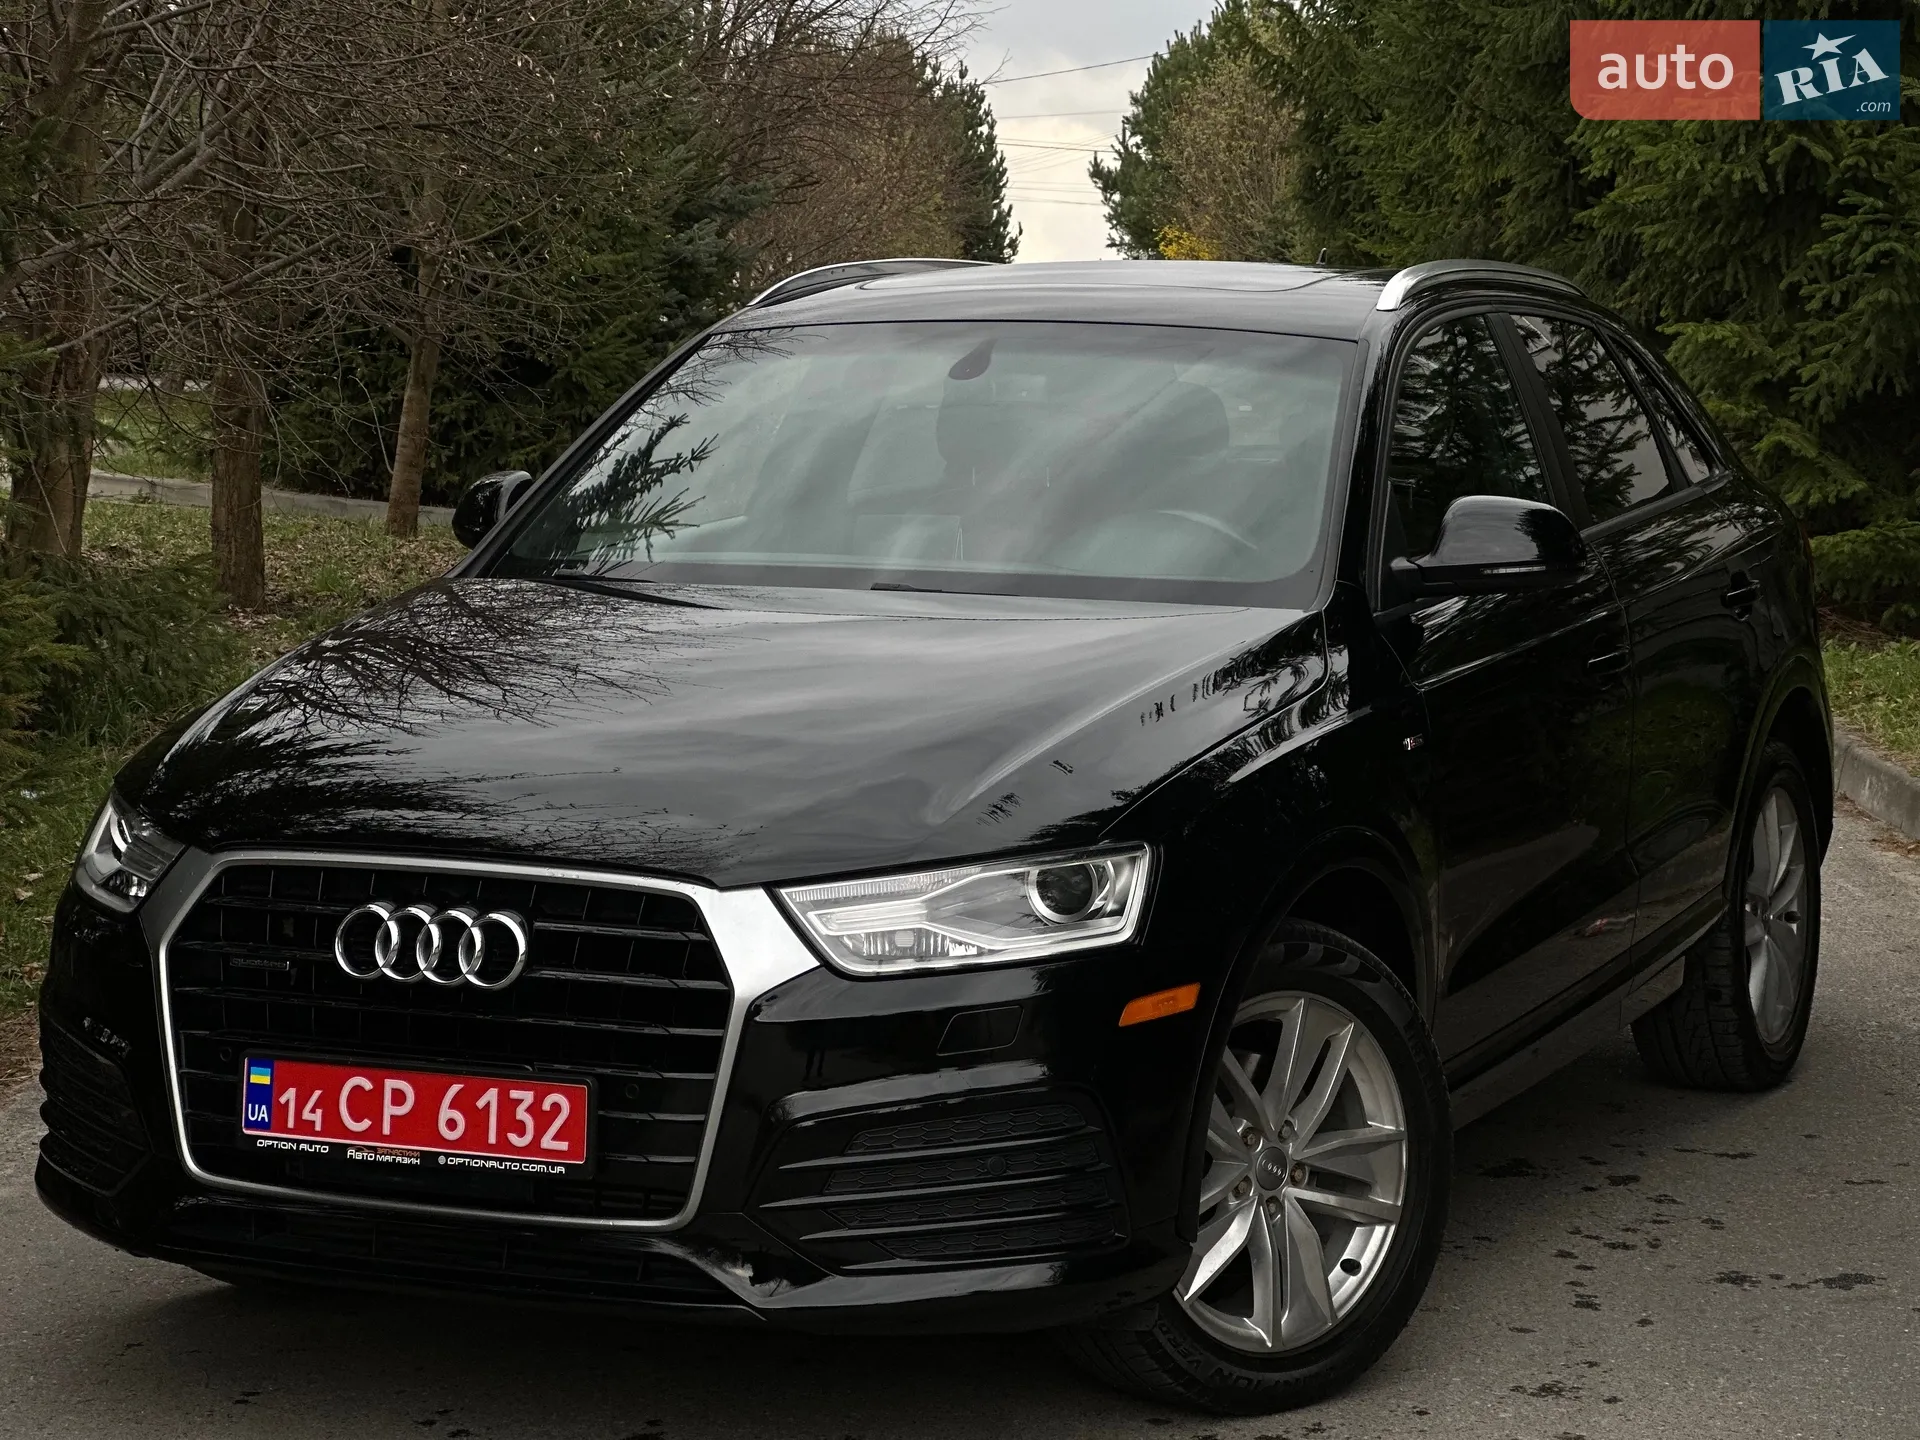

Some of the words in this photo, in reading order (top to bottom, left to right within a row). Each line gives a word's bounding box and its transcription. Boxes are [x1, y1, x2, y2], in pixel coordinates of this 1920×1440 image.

[247, 1103, 269, 1123] UA
[278, 1087, 323, 1132] 14
[437, 1083, 570, 1152] 6132
[299, 1143, 329, 1153] AUTO
